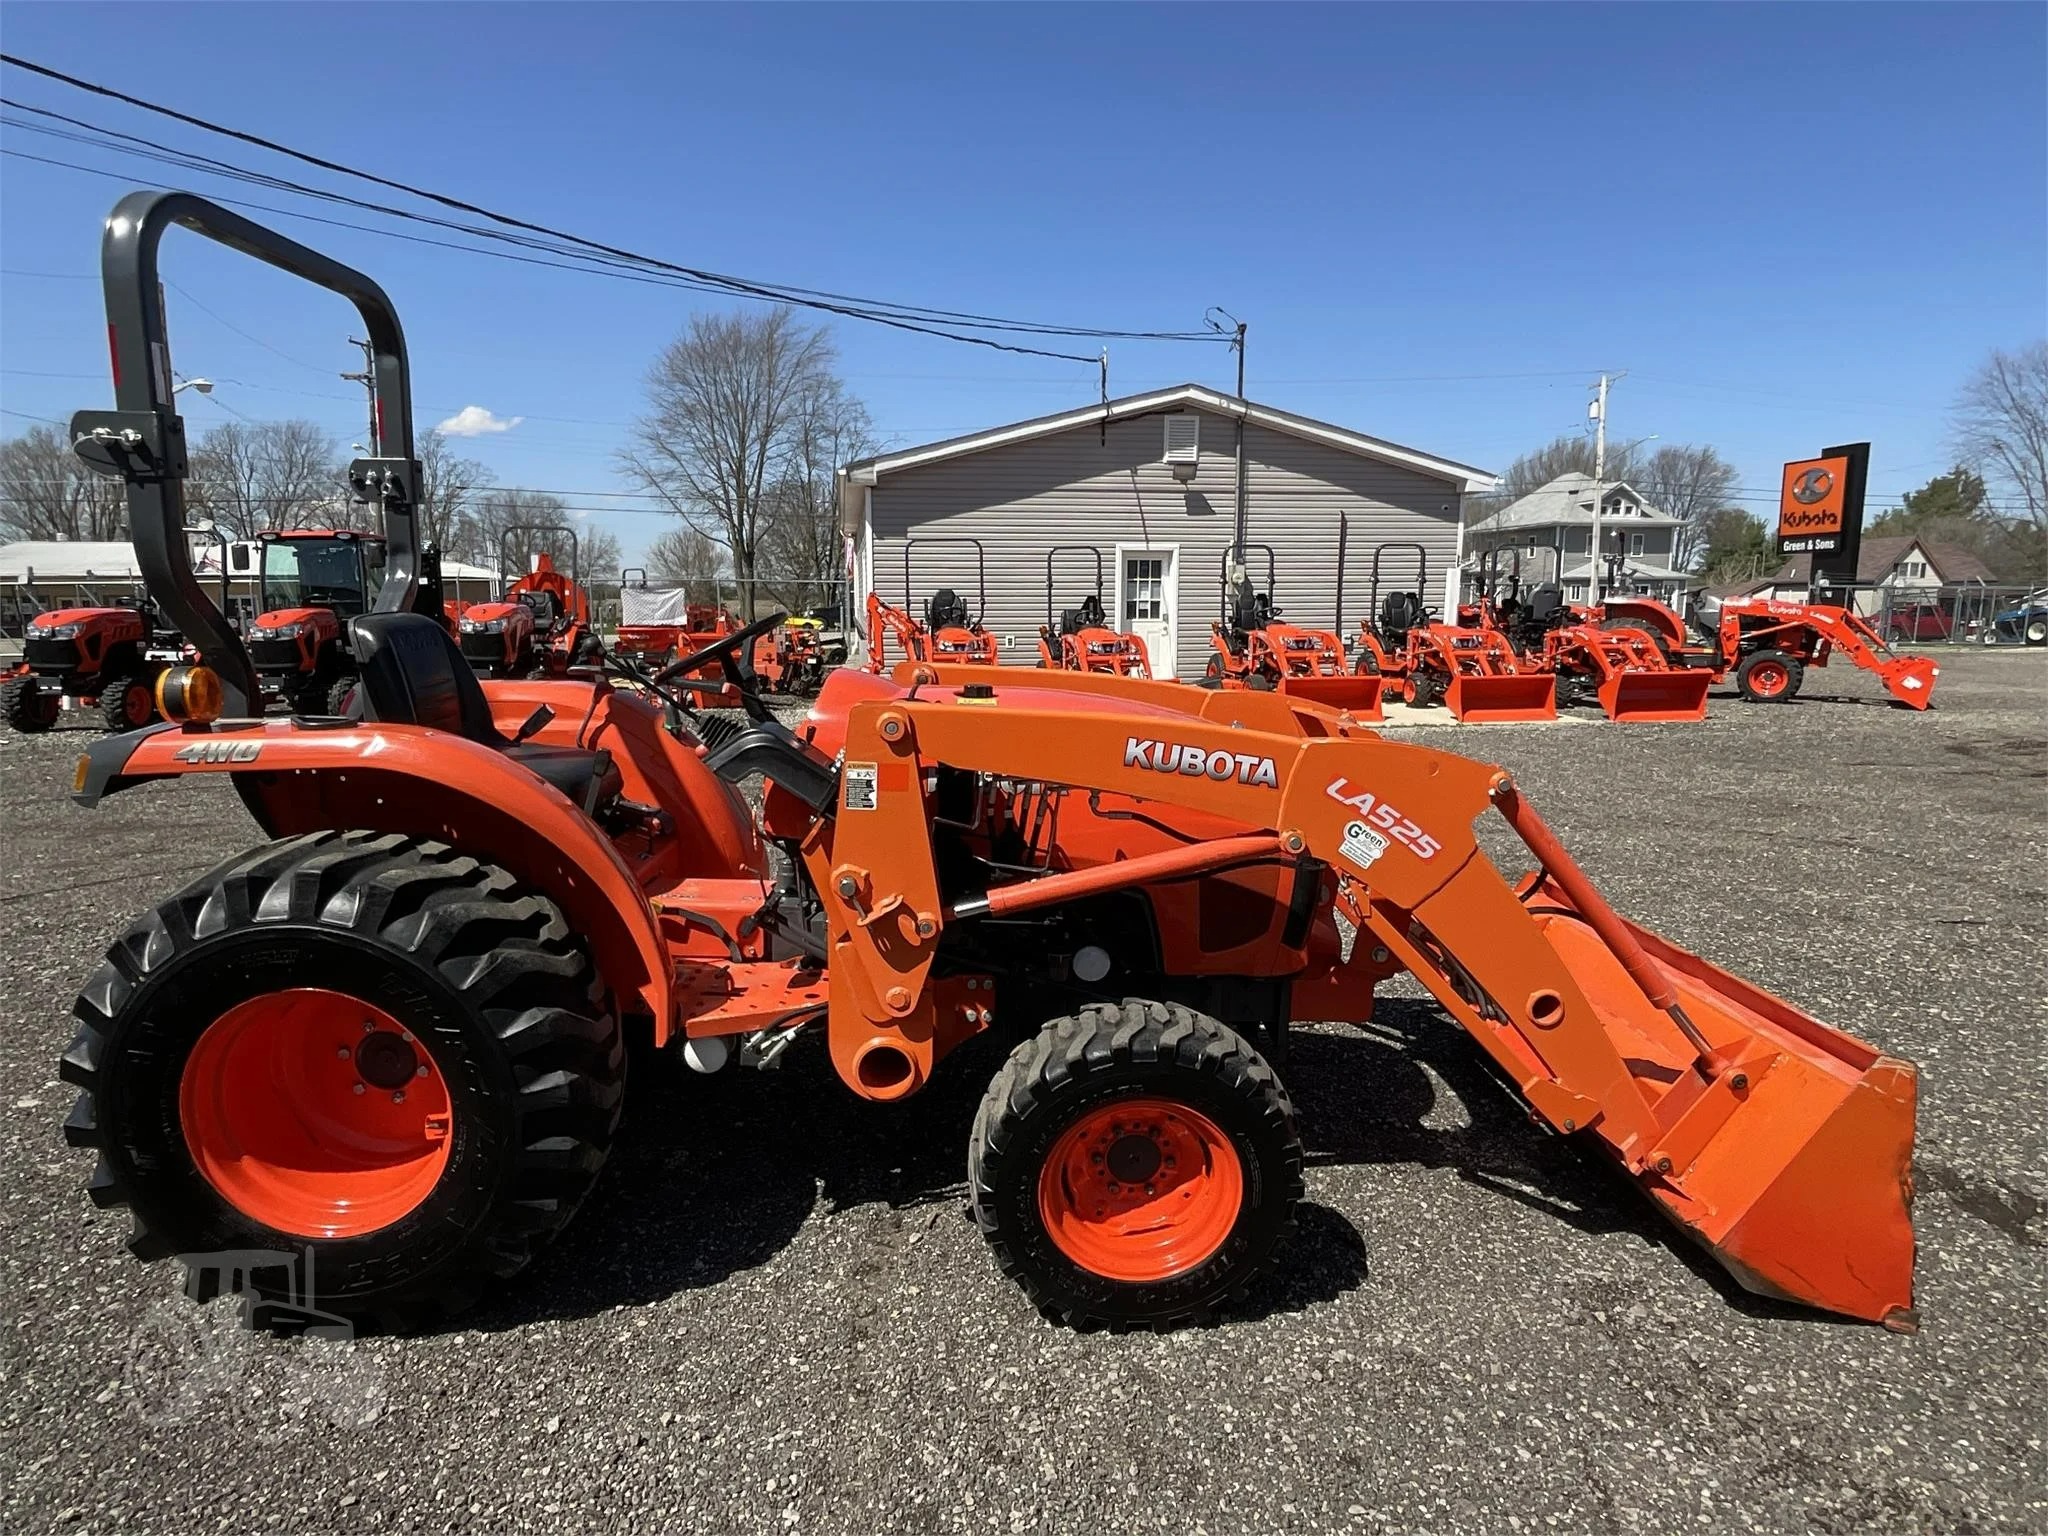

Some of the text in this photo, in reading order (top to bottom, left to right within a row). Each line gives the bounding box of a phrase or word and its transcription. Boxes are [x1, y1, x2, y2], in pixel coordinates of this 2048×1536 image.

[1783, 509, 1838, 527] Kubota
[1783, 539, 1835, 551] Green & Sons
[175, 742, 264, 763] 4WD
[1124, 737, 1279, 789] KUBOTA
[1326, 777, 1442, 859] LA525
[1347, 823, 1383, 847] Green
